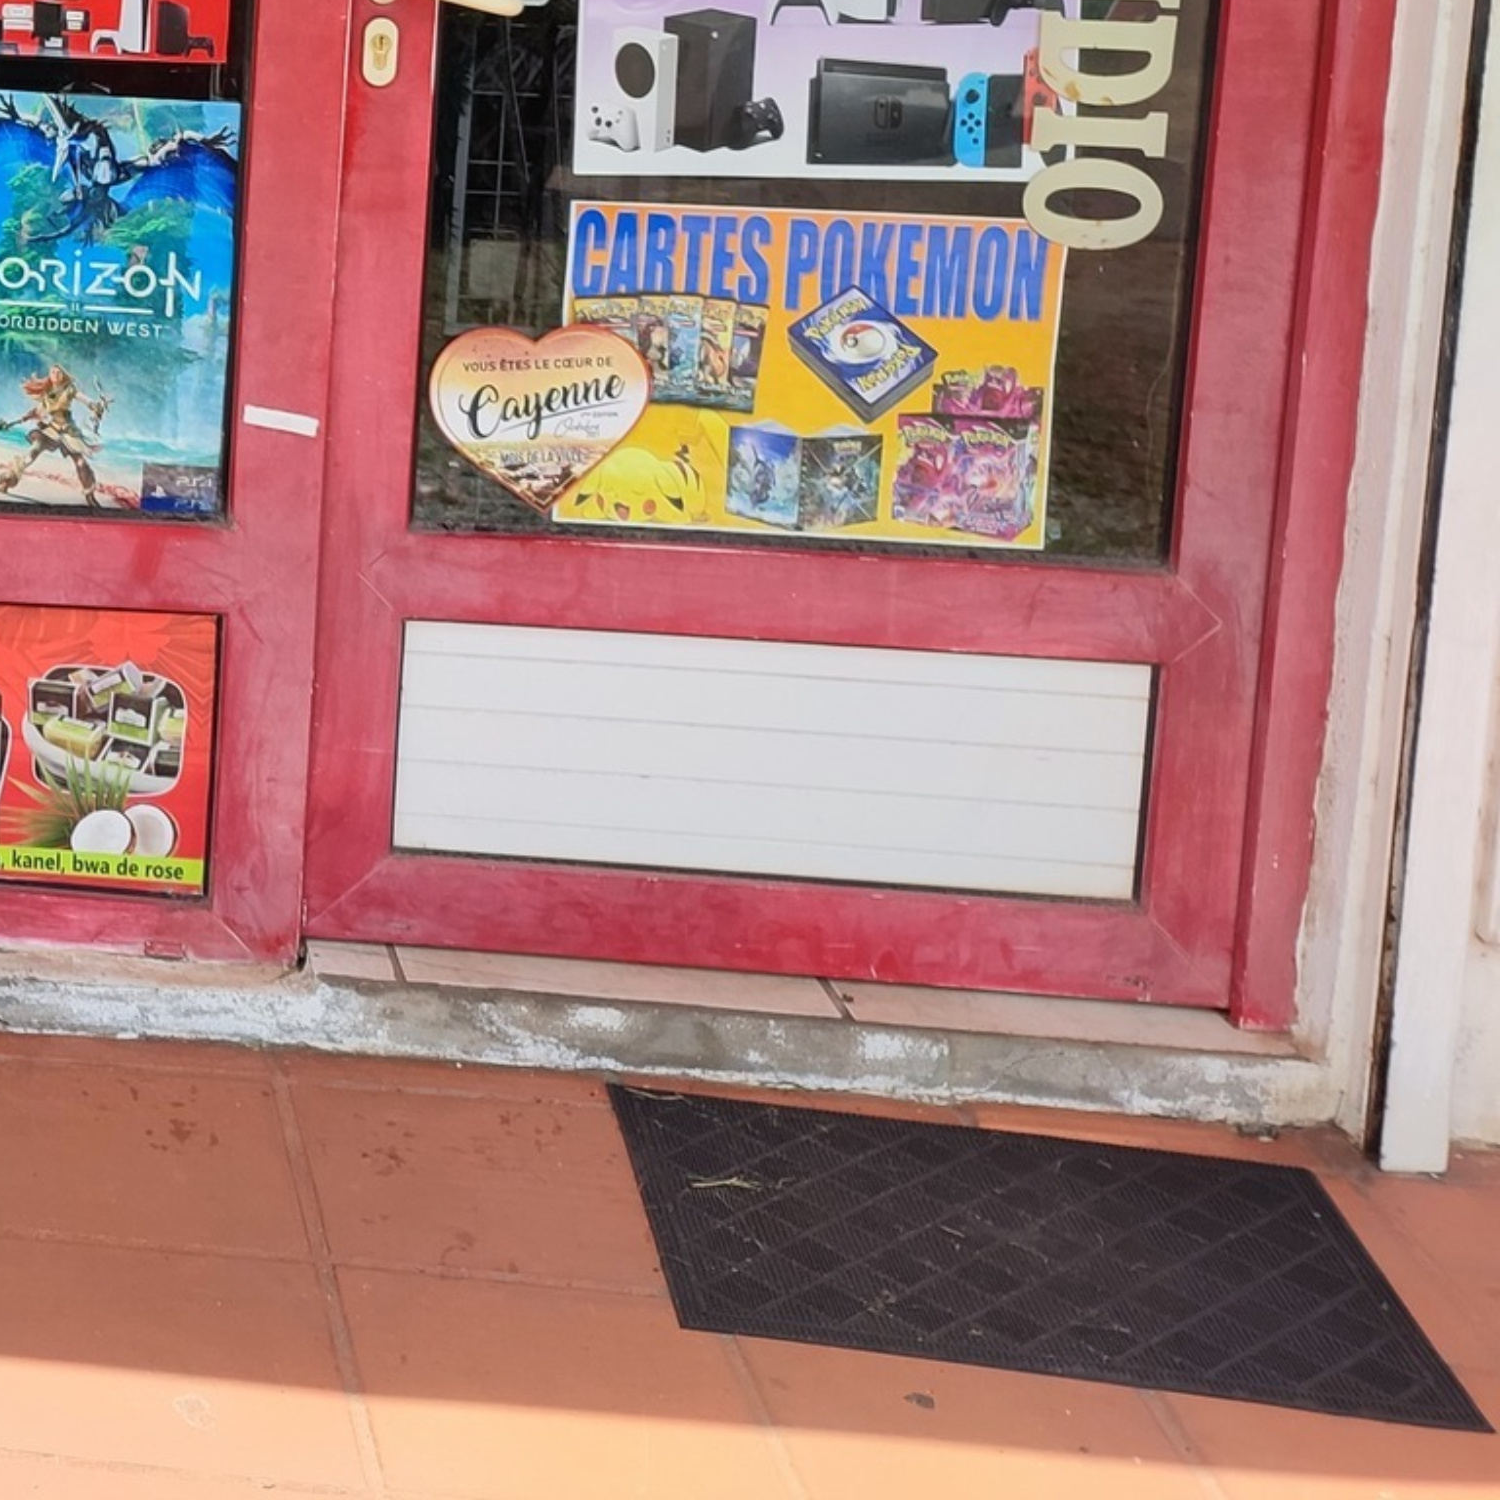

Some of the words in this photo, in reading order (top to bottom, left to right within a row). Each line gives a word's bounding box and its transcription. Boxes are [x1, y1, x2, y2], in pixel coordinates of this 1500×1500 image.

[572, 209, 771, 304] CARTES
[783, 218, 1051, 323] POKEMON
[108, 317, 163, 338] WEST
[462, 360, 496, 372] VOUS
[499, 357, 531, 371] ÊTES
[535, 358, 550, 370] LE
[596, 356, 614, 368] DE
[458, 373, 626, 440] Cayenne
[10, 850, 66, 874] kanel,
[71, 852, 111, 875] bwa
[115, 856, 139, 877] de
[144, 861, 185, 881] rose
